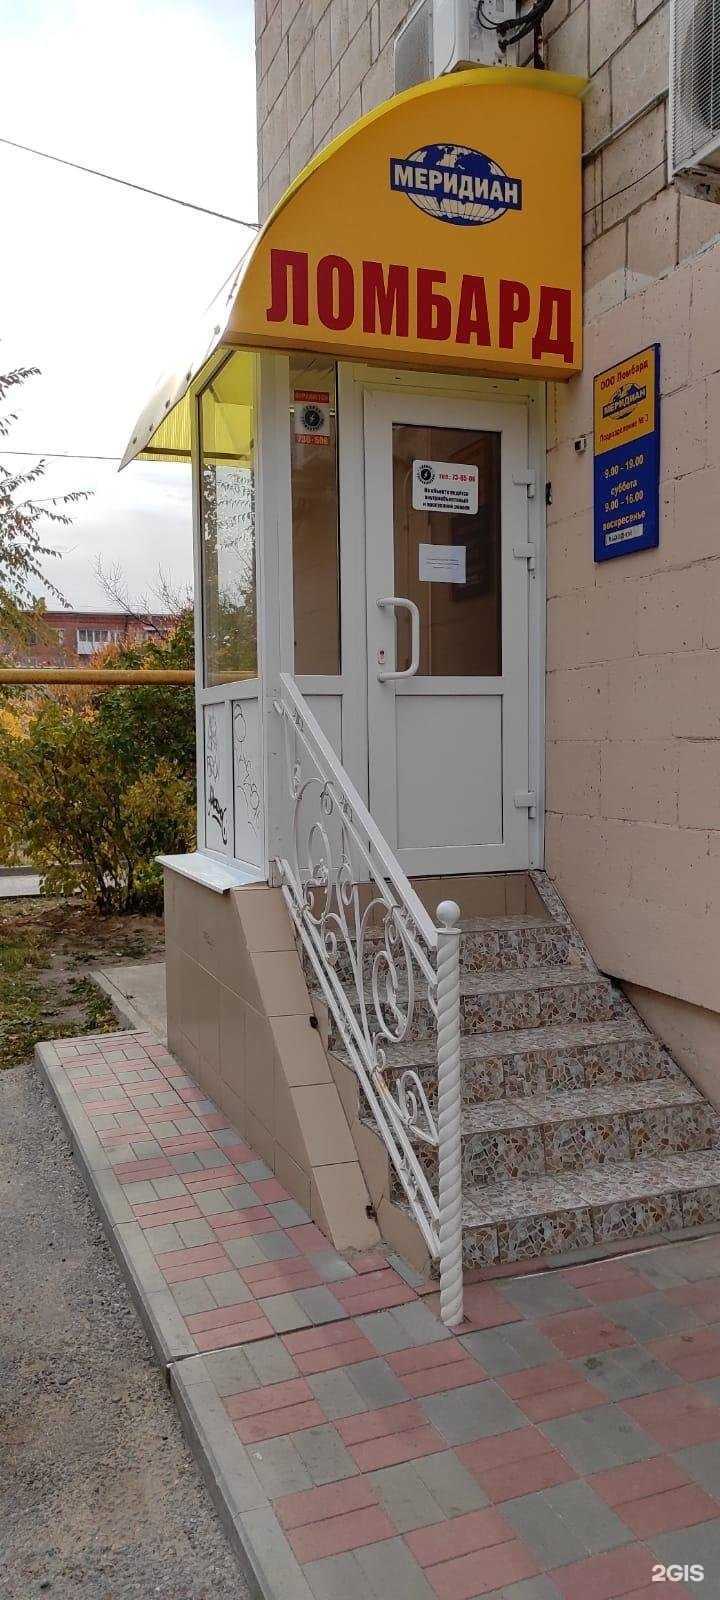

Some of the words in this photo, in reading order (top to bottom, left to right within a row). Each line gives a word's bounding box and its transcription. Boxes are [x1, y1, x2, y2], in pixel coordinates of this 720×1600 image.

[394, 164, 518, 204] МЕРИДИАН
[266, 248, 574, 364] ЛОМБАРД
[617, 360, 649, 381] Ломбард
[603, 388, 645, 415] МЕРИДИАН
[603, 465, 619, 479] 9.00
[625, 454, 644, 470] 19.00
[610, 479, 638, 497] суббота
[604, 498, 619, 512] 9.00
[603, 510, 646, 531] воскресенье
